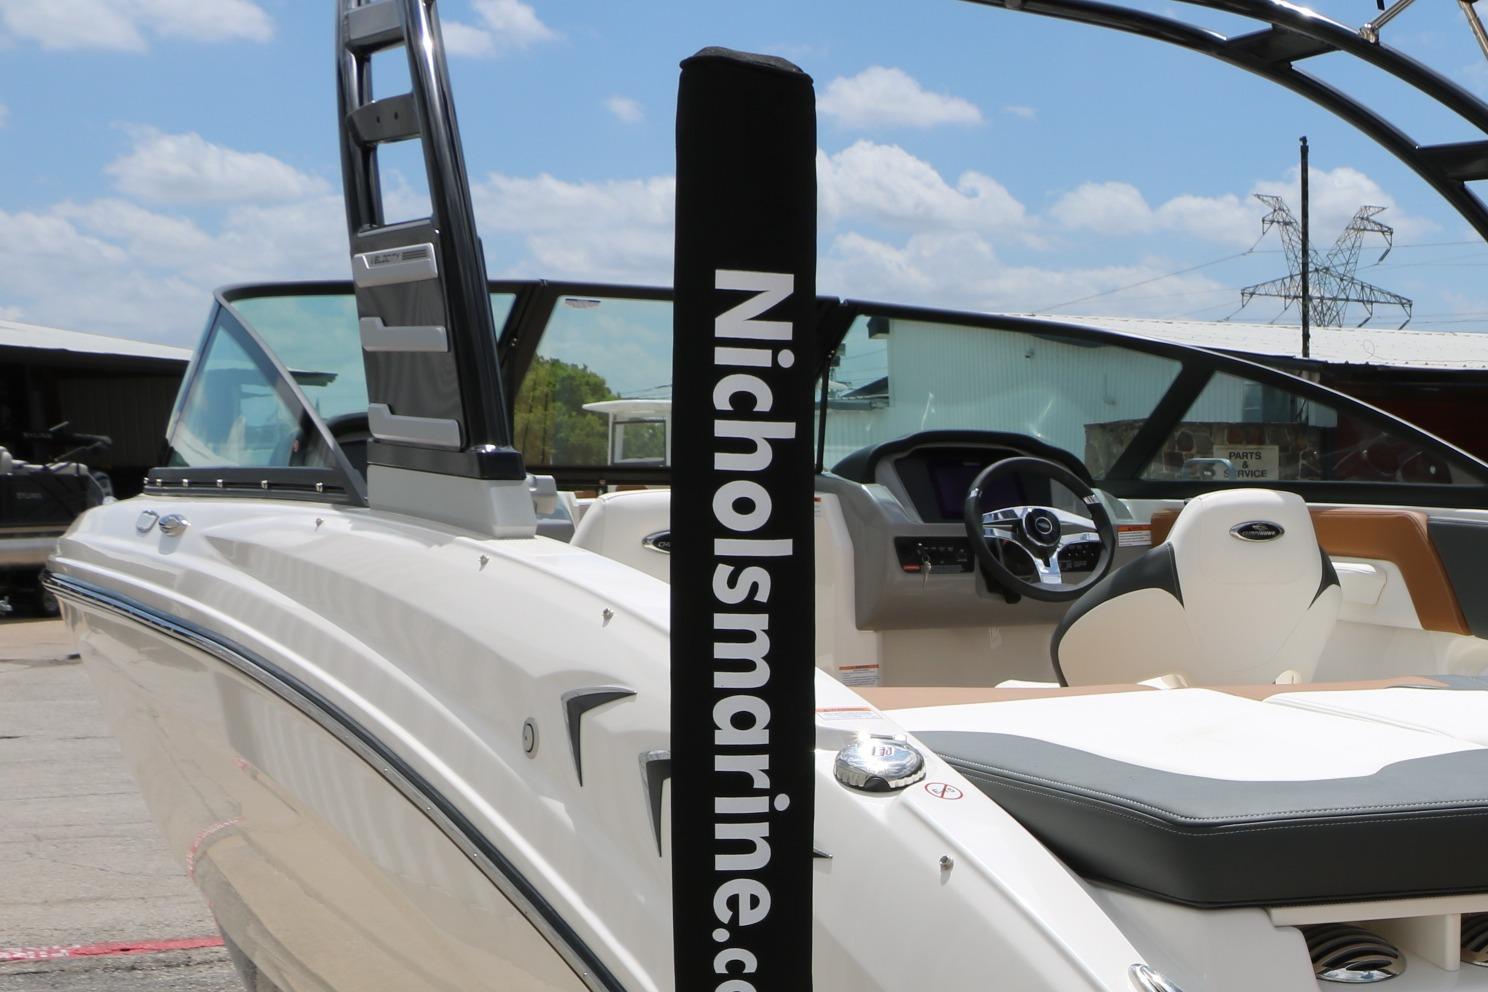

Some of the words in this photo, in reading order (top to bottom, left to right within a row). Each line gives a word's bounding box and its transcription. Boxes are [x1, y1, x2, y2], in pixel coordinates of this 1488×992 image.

[1229, 451, 1262, 460] PARTS
[1242, 461, 1249, 469] &
[1223, 469, 1267, 478] SRVICE
